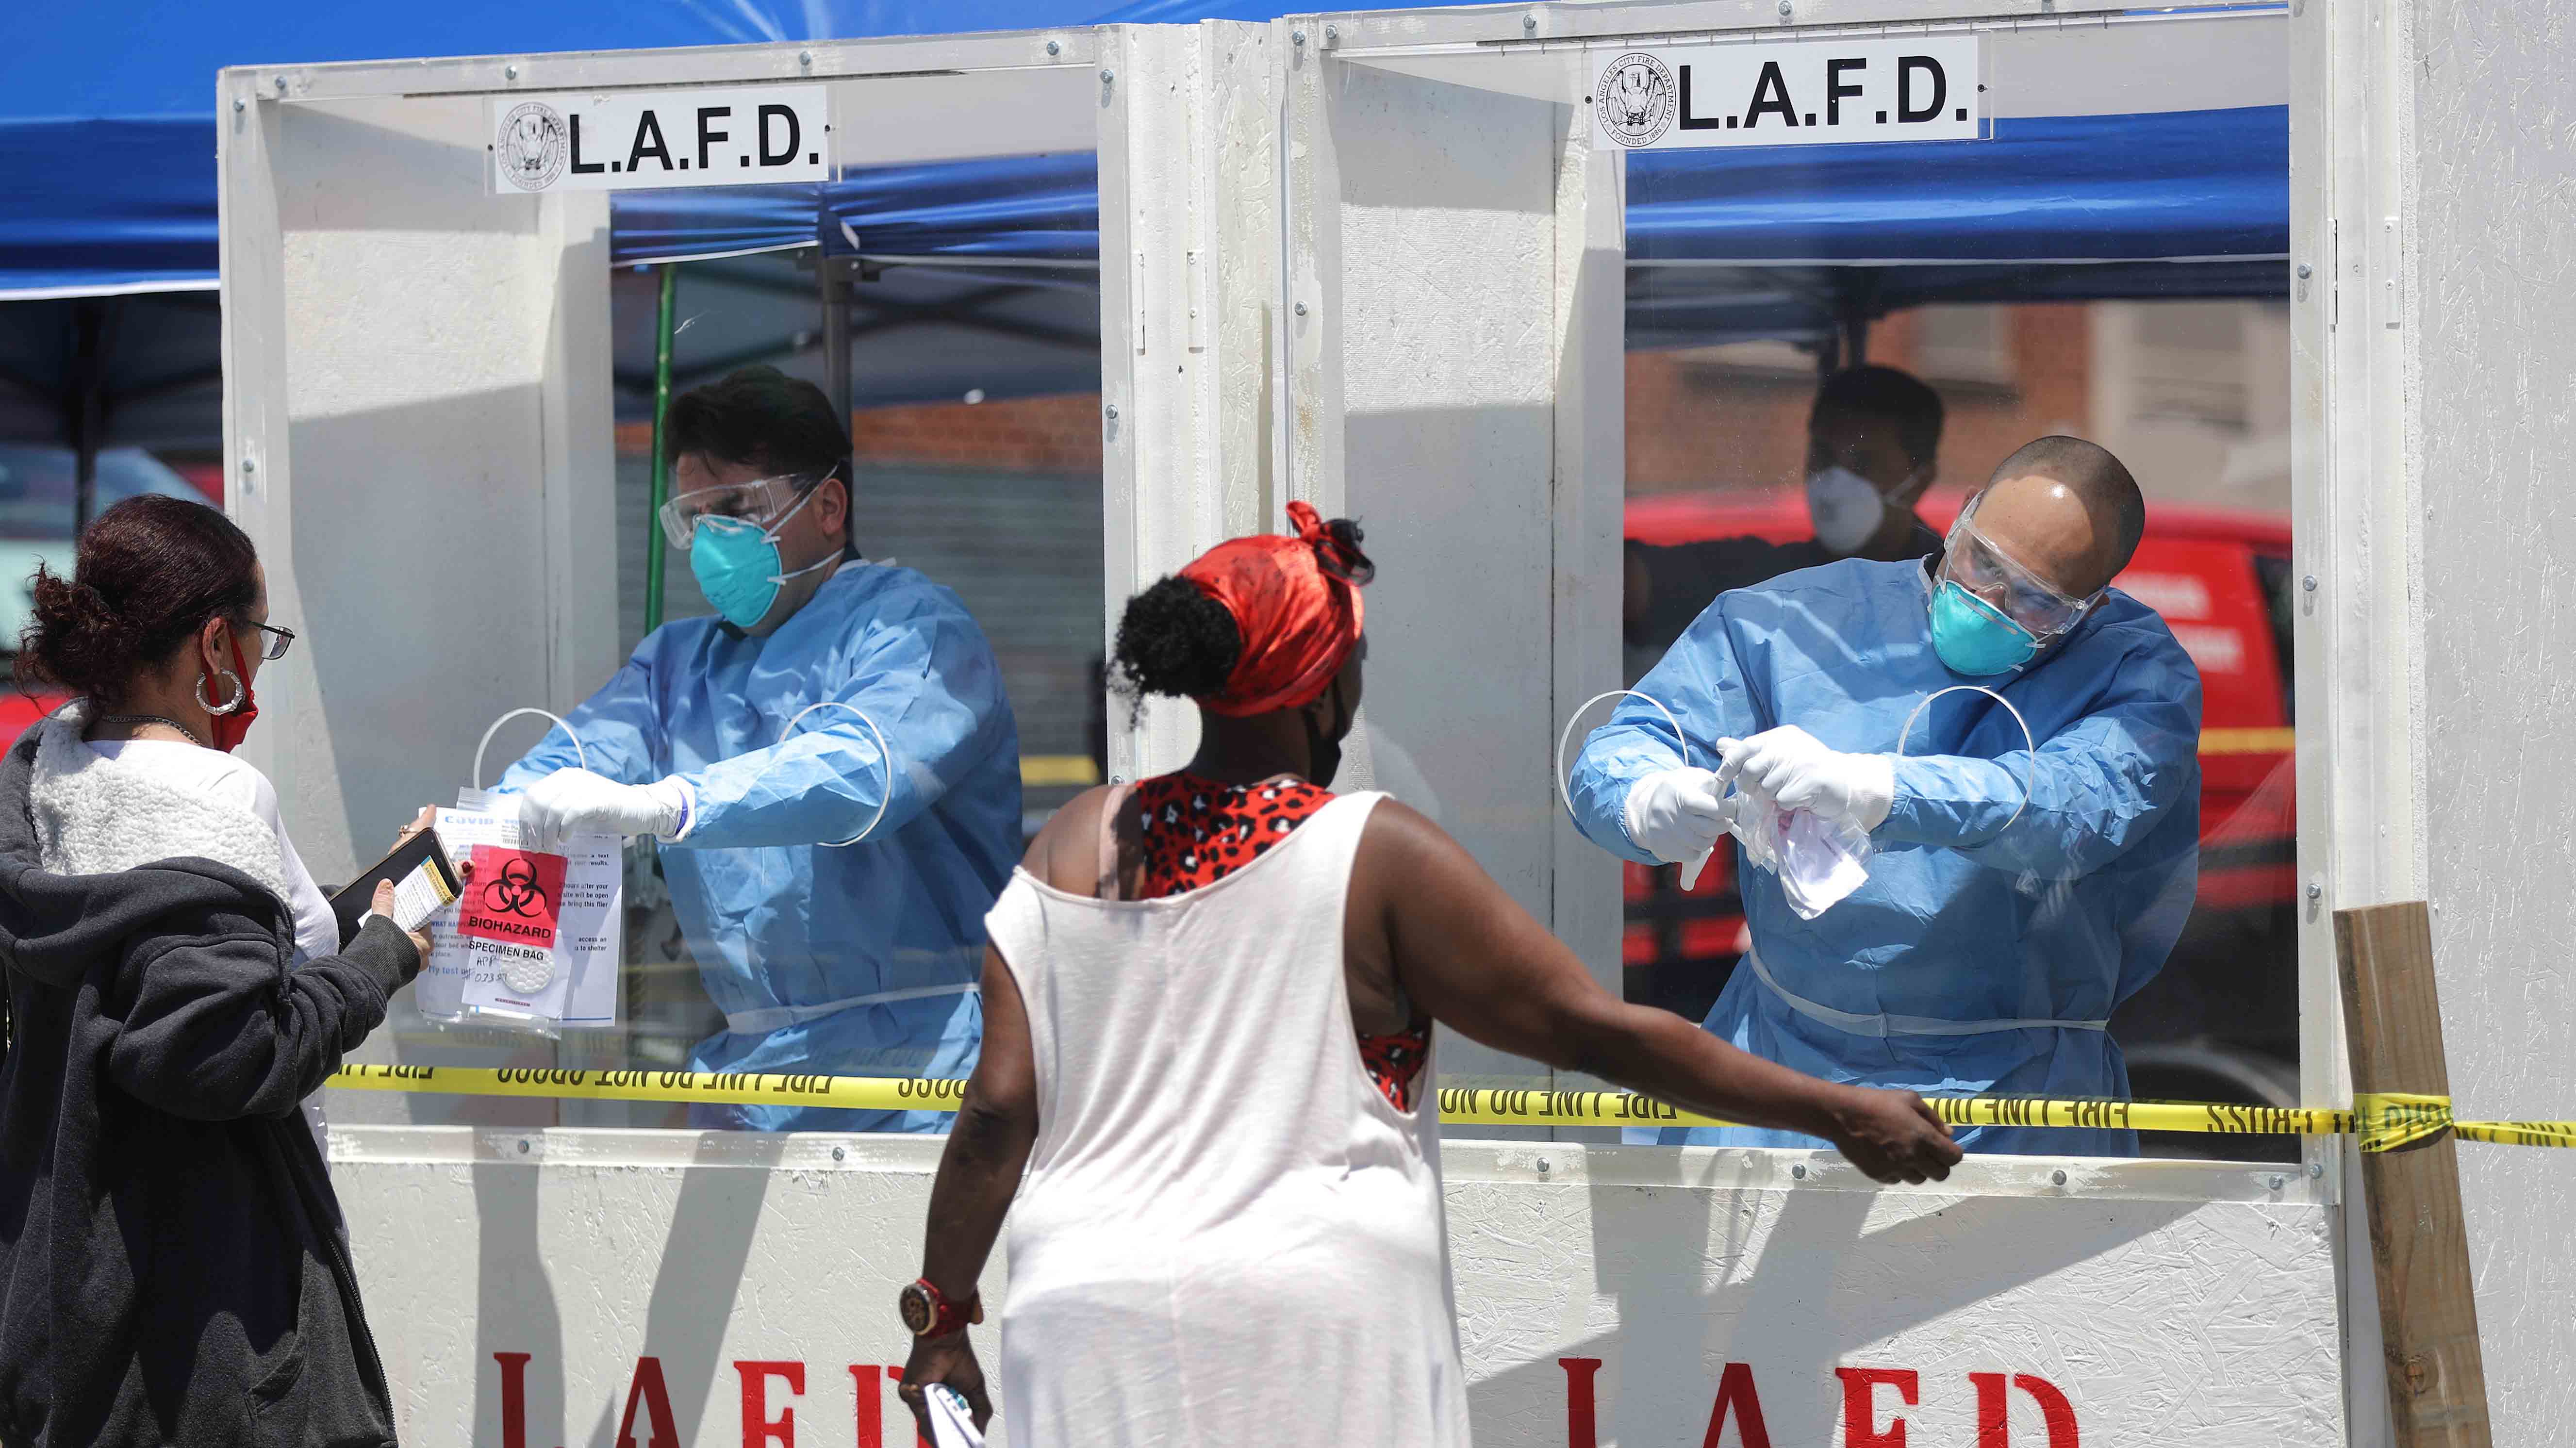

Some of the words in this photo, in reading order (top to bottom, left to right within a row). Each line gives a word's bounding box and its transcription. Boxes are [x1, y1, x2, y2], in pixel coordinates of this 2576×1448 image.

[1618, 56, 1635, 67] CITY
[1638, 56, 1655, 66] FIRE
[1599, 66, 1618, 104] ANGELES
[1655, 65, 1674, 121] DEPARTMENT
[1678, 55, 1968, 130] L.A.F.D.
[1600, 107, 1609, 124] LOS
[569, 104, 819, 174] L.A.F.D.
[1611, 129, 1647, 145] FOUNDED
[1650, 127, 1662, 140] 1886
[469, 916, 551, 939] BIOHAZARD
[469, 940, 520, 957] SPECIMEN
[523, 950, 544, 961] BAG
[1438, 1088, 1479, 1114] NO
